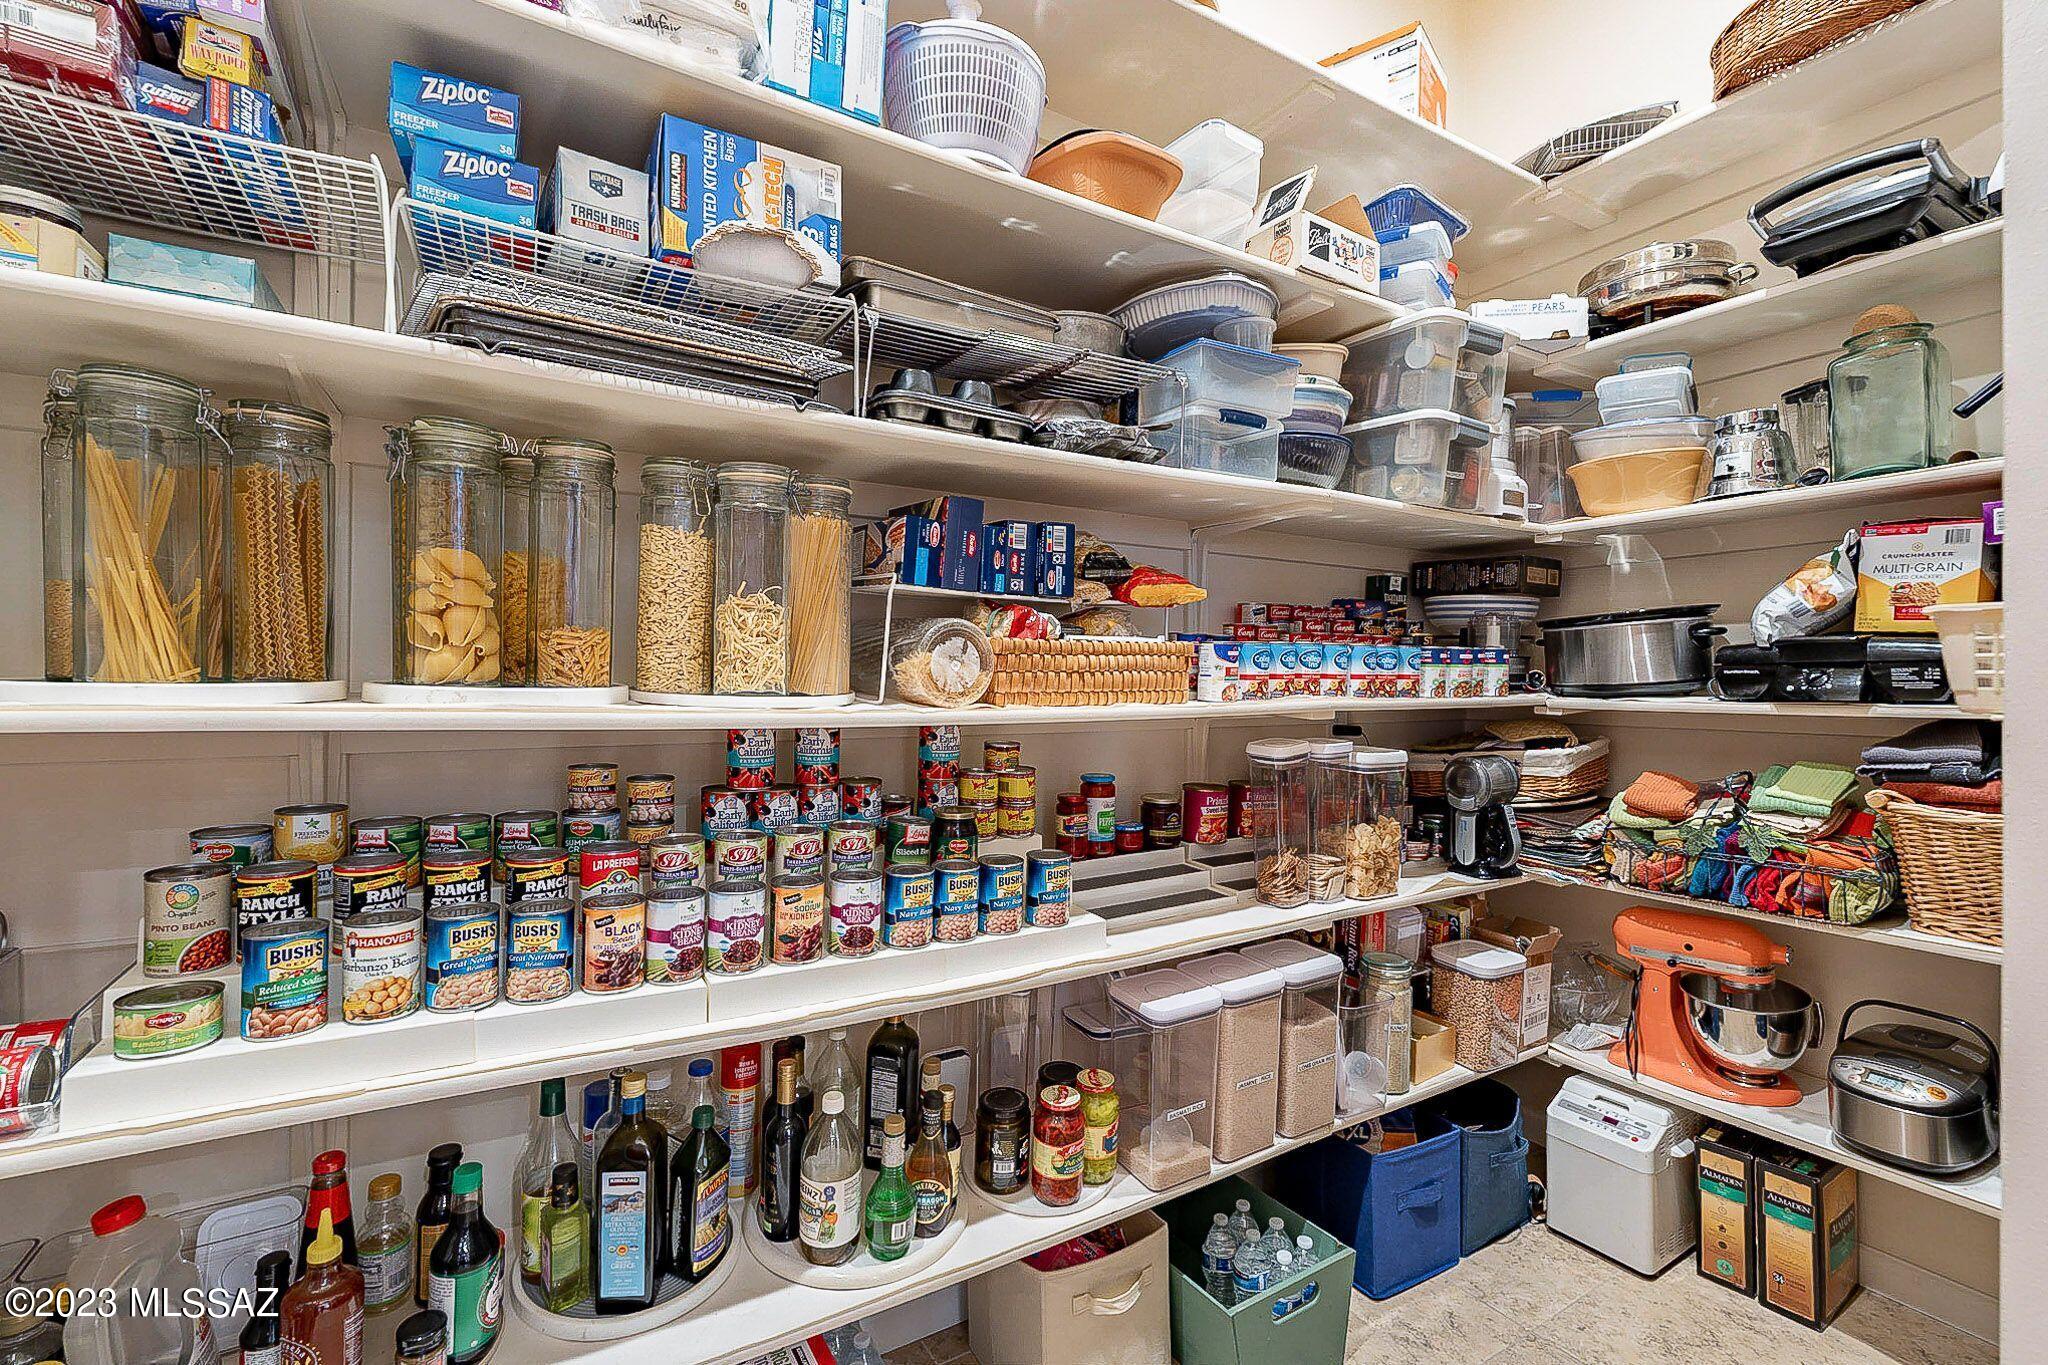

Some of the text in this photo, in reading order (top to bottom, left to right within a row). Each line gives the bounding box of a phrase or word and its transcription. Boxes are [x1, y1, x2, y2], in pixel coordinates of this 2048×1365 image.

[420, 76, 493, 106] Ziploc
[393, 118, 425, 132] GALLON
[394, 111, 440, 130] FREEZER
[443, 150, 513, 180] Ziploc
[702, 129, 718, 190] KITCHEN
[670, 153, 682, 209] KIRKLAND
[416, 184, 461, 203] FREEZER
[571, 203, 607, 226] TRASH
[610, 214, 640, 233] BAGS
[1531, 301, 1566, 312] PEARS
[1881, 551, 1957, 560] CRUNCHMASTER
[1873, 562, 1964, 574] MULTI-GRAIN
[748, 737, 771, 748] Early
[802, 735, 825, 746] Early
[717, 810, 744, 821] Early
[434, 879, 486, 896] RANCH
[525, 875, 569, 893] RANCH
[949, 877, 979, 891] BUSH'S
[998, 873, 1024, 887] BUSH'S
[904, 882, 934, 897] BUSH'S
[1041, 891, 1059, 902] Navy
[241, 893, 301, 910] RANCH
[793, 902, 821, 912] SODIUM
[944, 903, 963, 913] Navy
[993, 899, 1011, 910] Navy
[239, 907, 305, 925] STYLE
[842, 907, 876, 918] KIDNEY
[898, 908, 919, 920] Navy
[151, 918, 217, 934] PINTO BEANS
[514, 923, 559, 939] BUSH'S
[604, 921, 643, 937] BLACK
[726, 918, 763, 933] KIDNEY
[729, 927, 760, 938] BEANS
[358, 932, 413, 948] HANOVER
[451, 923, 497, 945] BUSH'S
[676, 935, 703, 948] BEANS
[269, 941, 324, 965] BUSH'S
[527, 952, 566, 963] Northern
[1347, 946, 1358, 972] Rice
[442, 960, 469, 971] Great
[258, 977, 300, 997] Reduced
